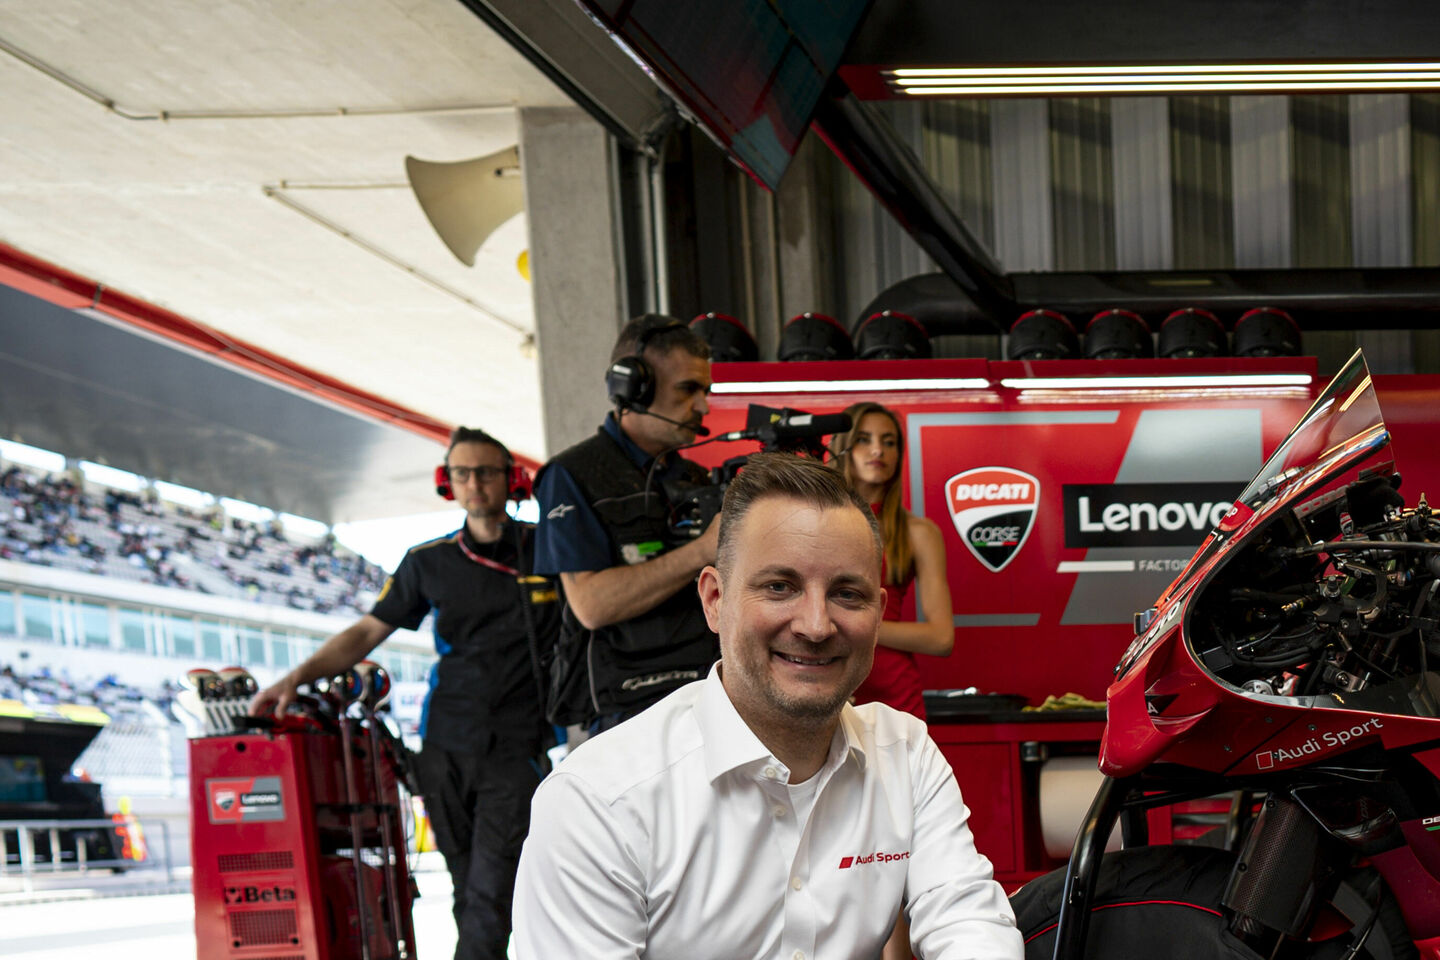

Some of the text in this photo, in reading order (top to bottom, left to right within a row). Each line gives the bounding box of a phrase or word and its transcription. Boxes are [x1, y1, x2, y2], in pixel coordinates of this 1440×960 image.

[956, 483, 1030, 501] DUCATI
[970, 526, 1021, 542] CORSE
[1278, 717, 1384, 762] Audi Sport
[855, 851, 910, 865] Audi Sport
[244, 886, 296, 903] Beta
